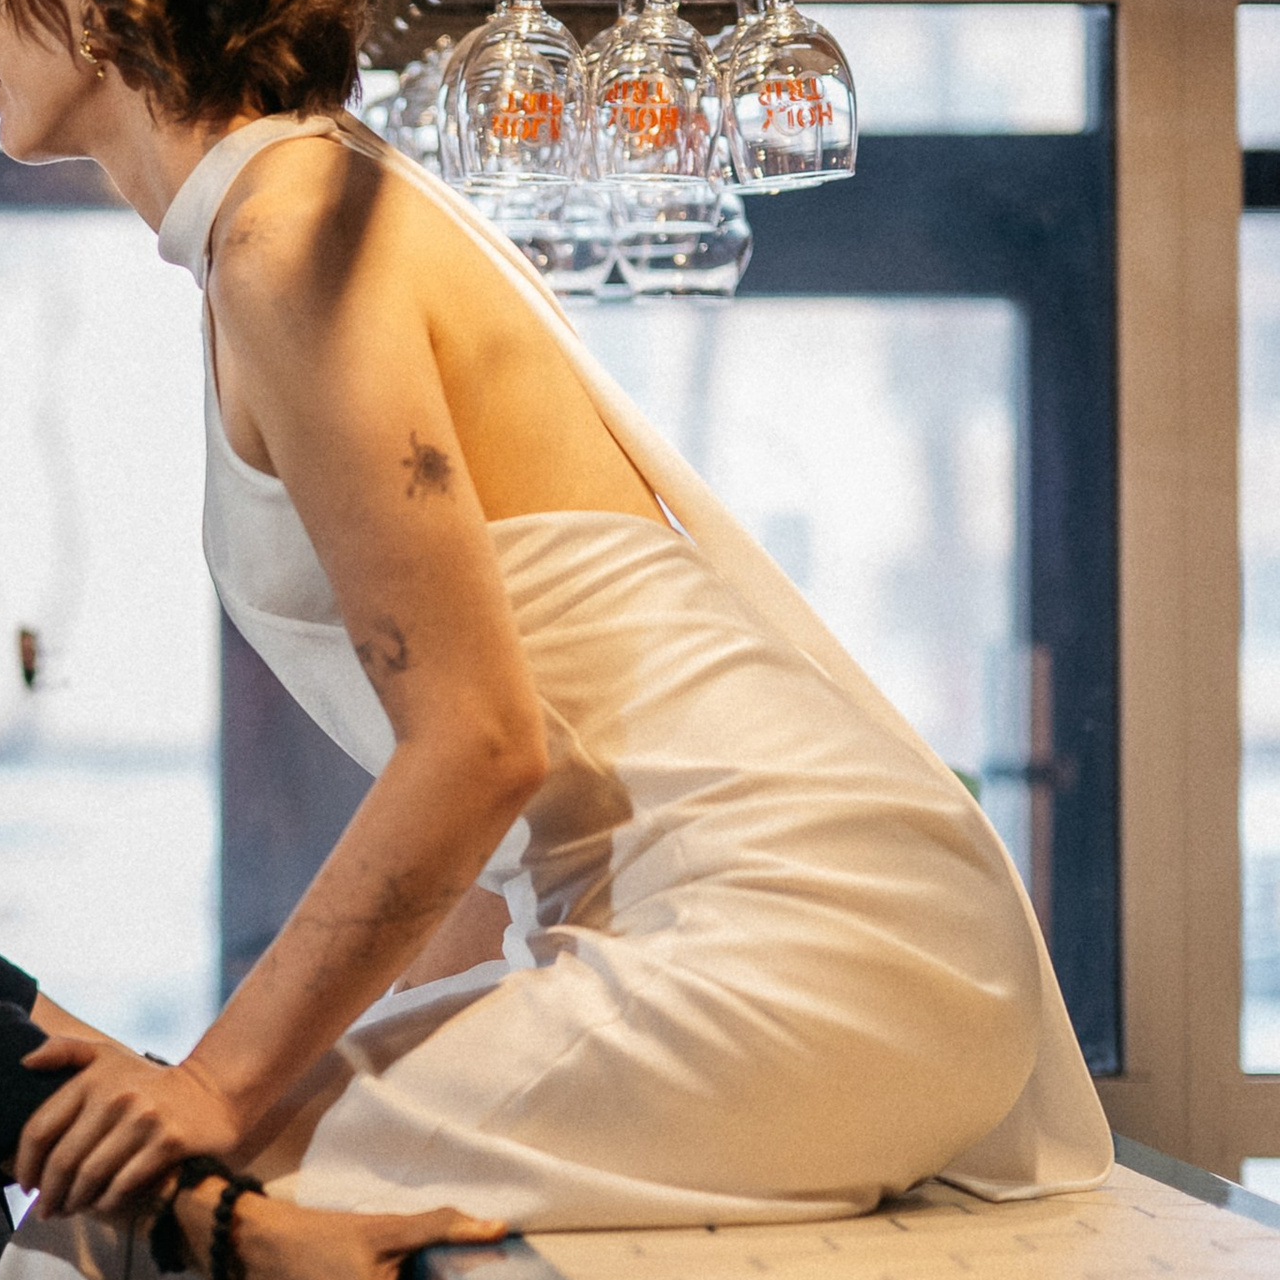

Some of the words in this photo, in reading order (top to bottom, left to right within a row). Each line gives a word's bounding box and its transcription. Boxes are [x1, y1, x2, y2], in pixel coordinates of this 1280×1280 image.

[606, 80, 670, 104] TRIP
[758, 76, 824, 106] TRIP
[607, 106, 679, 132] HOLY
[761, 102, 833, 132] HOLY
